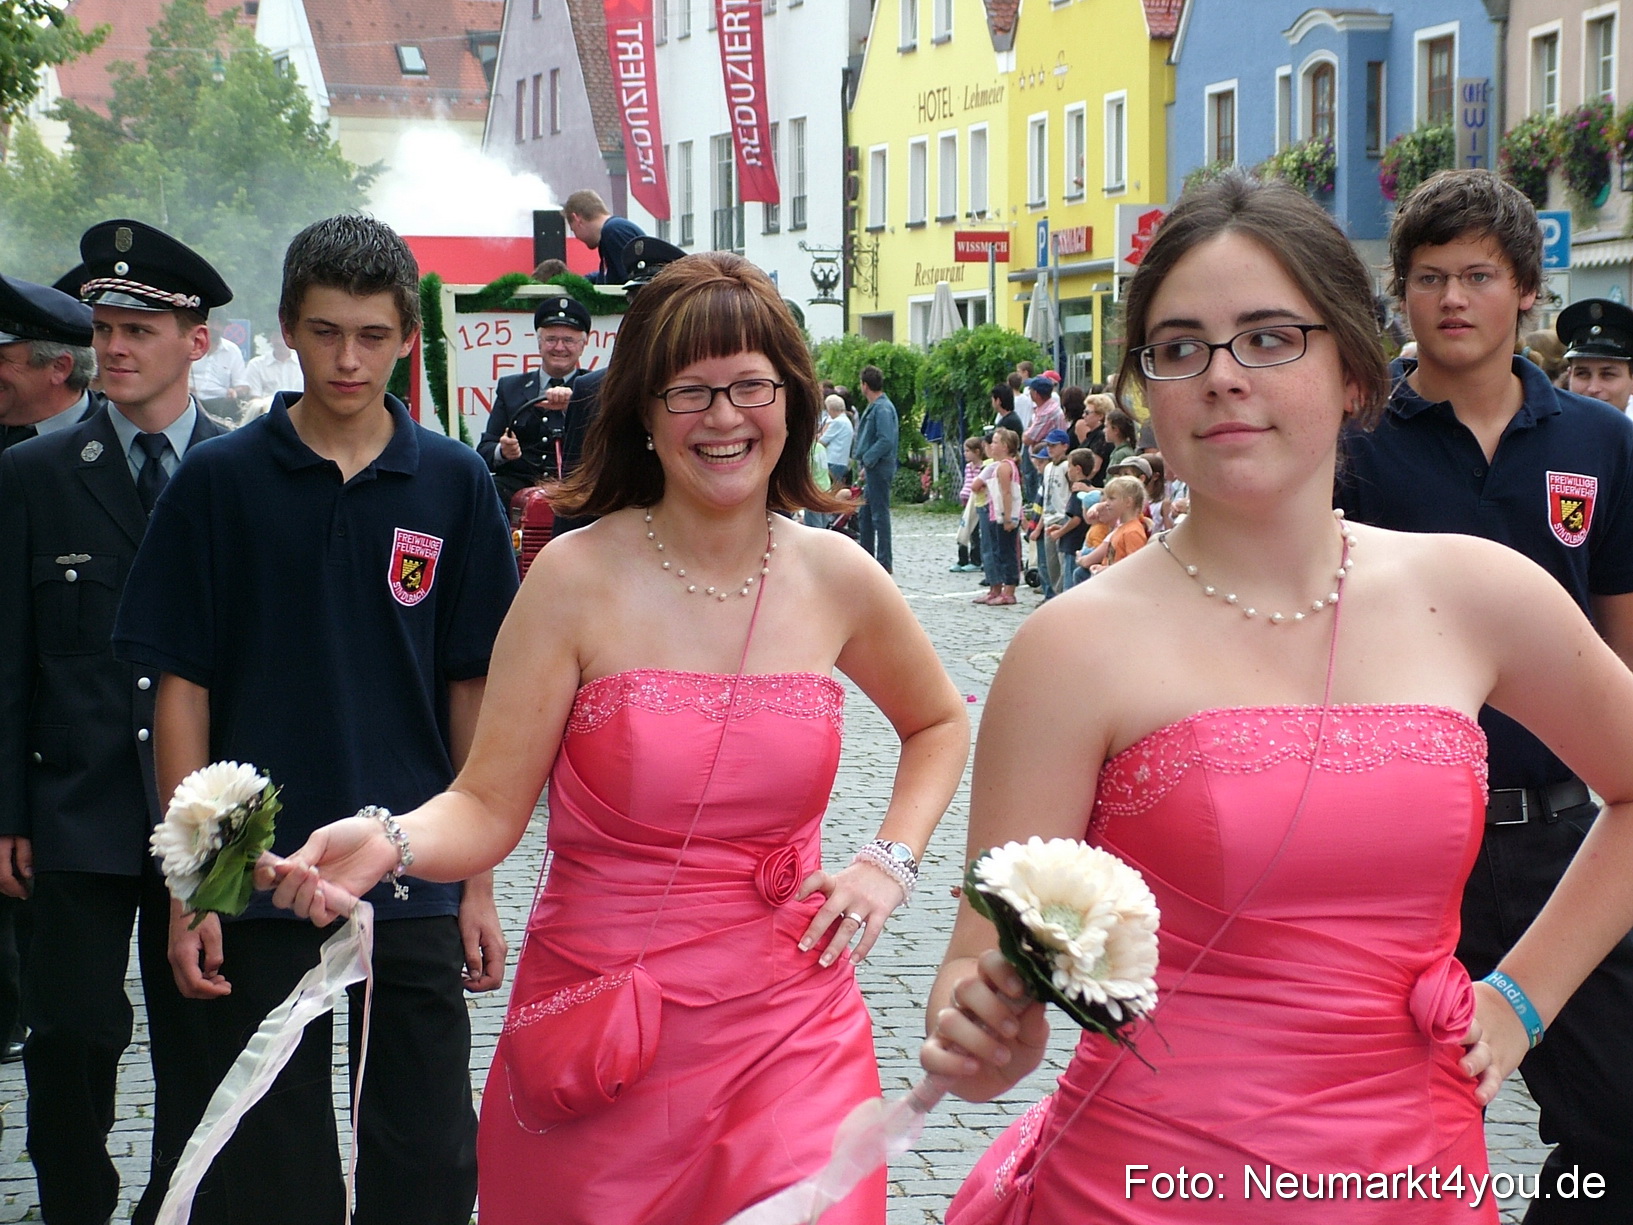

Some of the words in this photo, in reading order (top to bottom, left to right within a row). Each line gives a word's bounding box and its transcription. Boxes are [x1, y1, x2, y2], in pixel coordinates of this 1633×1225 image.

[917, 86, 954, 124] HOTEL
[963, 79, 1005, 111] Lehmeier
[957, 241, 1008, 252] WISSMCH
[1038, 226, 1046, 262] P
[914, 261, 965, 287] Restaurant
[458, 319, 512, 351] 125
[1550, 475, 1596, 489] FREIWILLIGE
[1550, 484, 1595, 498] FEUERWEHR
[396, 541, 438, 560] FEUERWEHR
[398, 532, 441, 551] FREIWILLIGE
[1488, 973, 1528, 1015] Heldin
